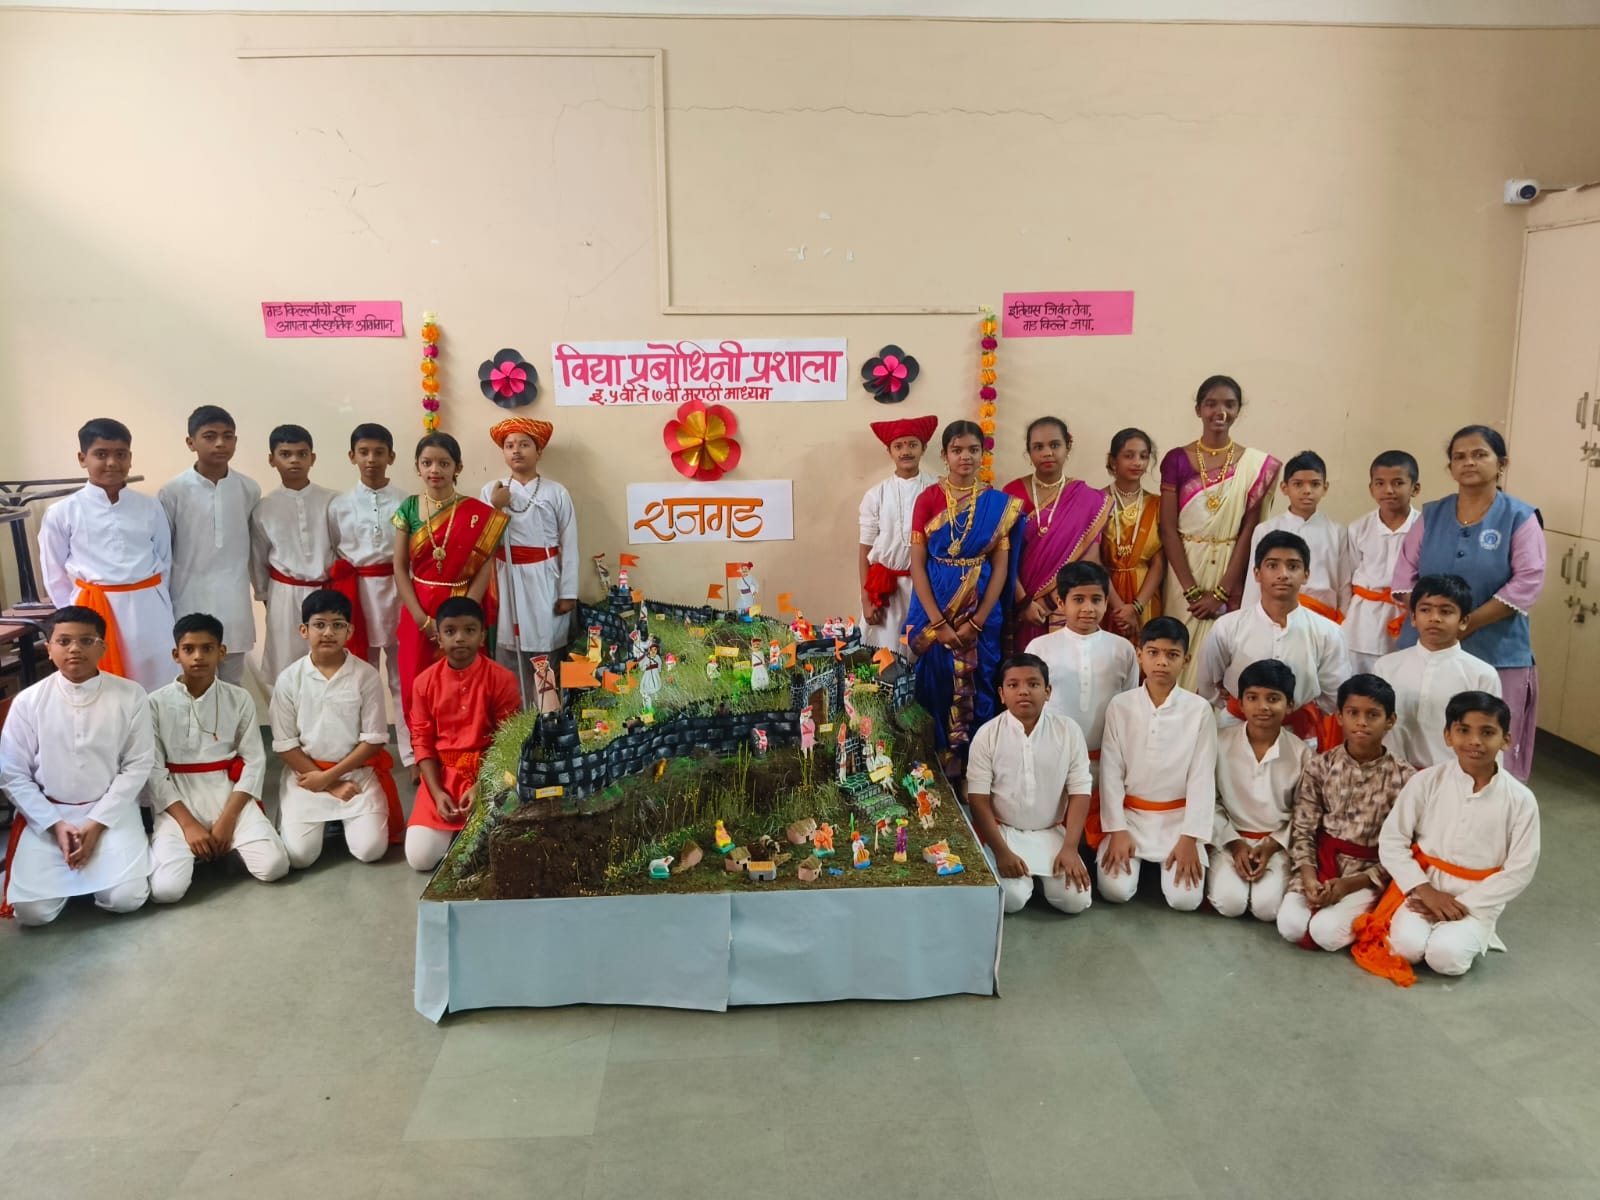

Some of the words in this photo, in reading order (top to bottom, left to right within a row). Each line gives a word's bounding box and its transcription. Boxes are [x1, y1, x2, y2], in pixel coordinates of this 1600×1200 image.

[266, 305, 283, 317] गड
[333, 305, 356, 317] शान
[276, 320, 309, 332] आपला
[1023, 320, 1038, 331] गड
[555, 344, 626, 387] विद्या
[627, 340, 750, 385] प्रबोधिनी
[745, 351, 844, 383] प्रशाला
[681, 382, 723, 402] मराठी
[724, 386, 773, 401] माध्यम
[634, 497, 763, 541] राजगड
